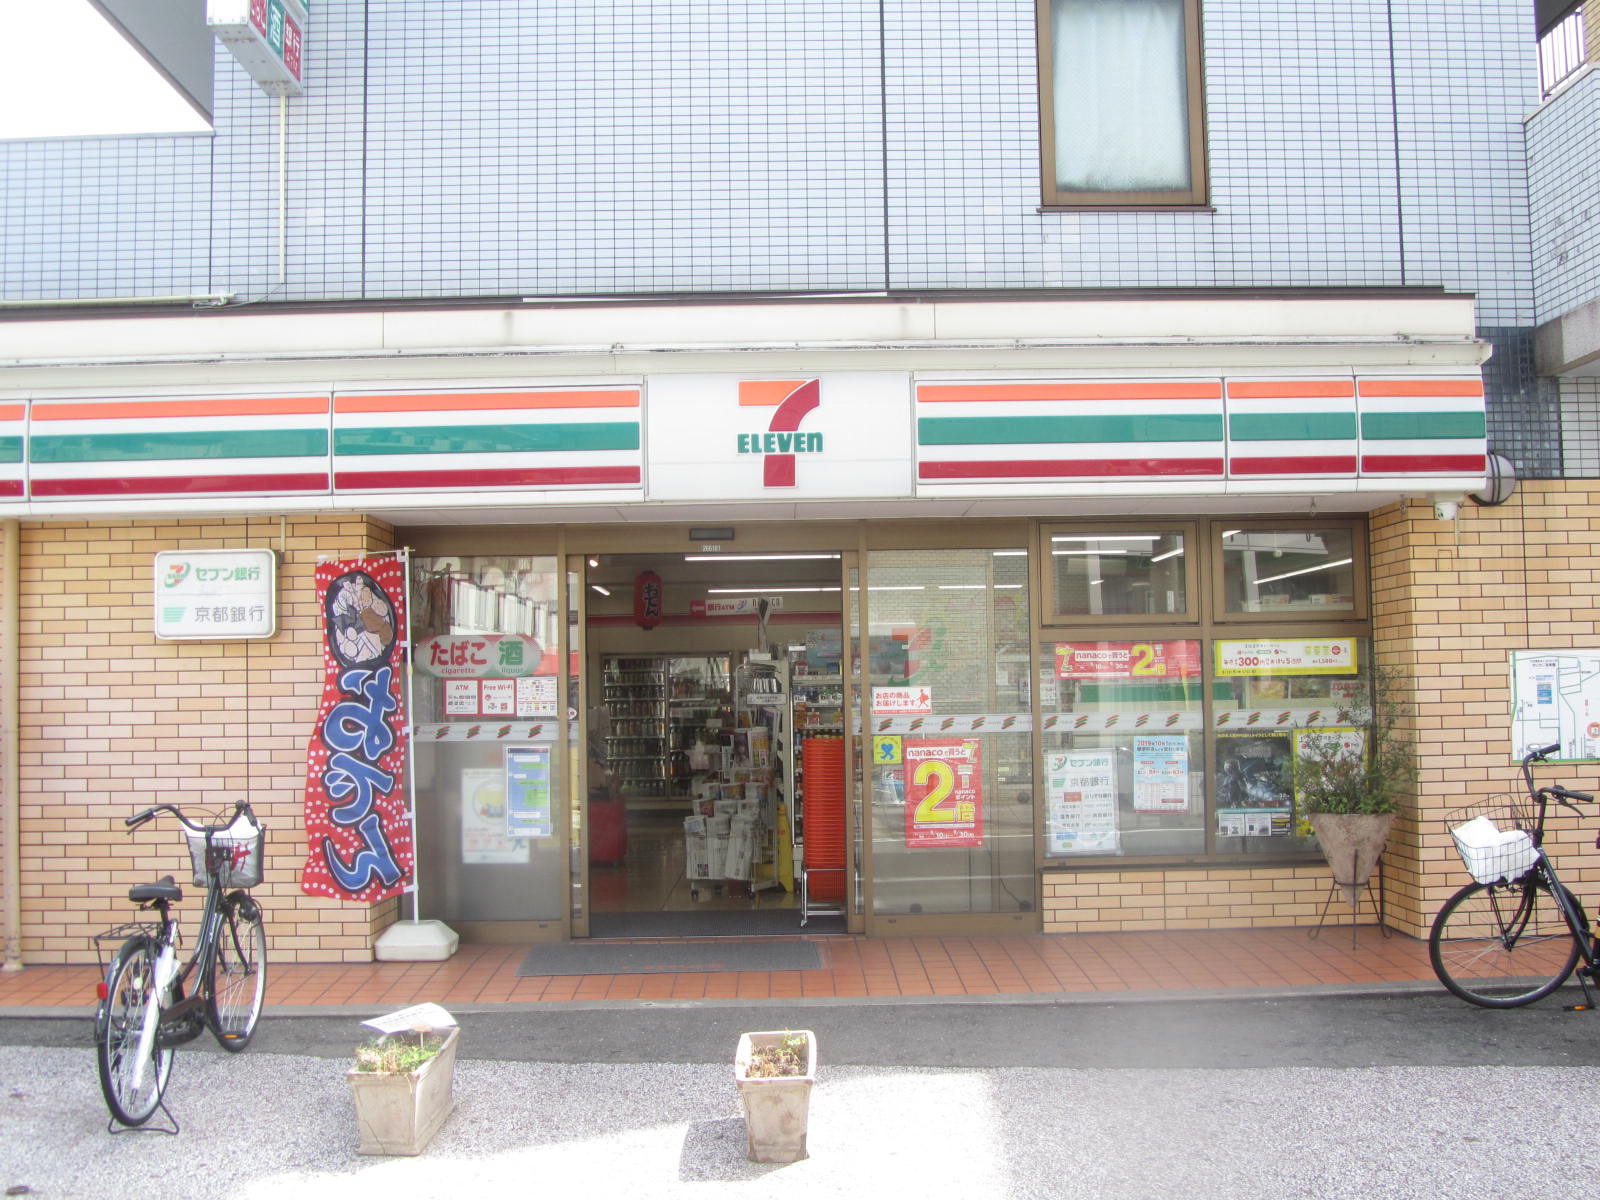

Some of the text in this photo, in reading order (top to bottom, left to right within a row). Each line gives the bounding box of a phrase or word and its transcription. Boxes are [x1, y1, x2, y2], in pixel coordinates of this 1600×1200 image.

[194, 566, 261, 582] セブン銀行
[643, 583, 660, 617] おでん
[194, 605, 265, 623] 京都銀行
[429, 640, 524, 666] たばこ 酒
[441, 667, 476, 675] cigarette
[875, 691, 910, 699] お店の商品
[1069, 758, 1110, 768] セブン銀行
[322, 666, 403, 893] おでん
[1069, 776, 1110, 787] 京都銀行
